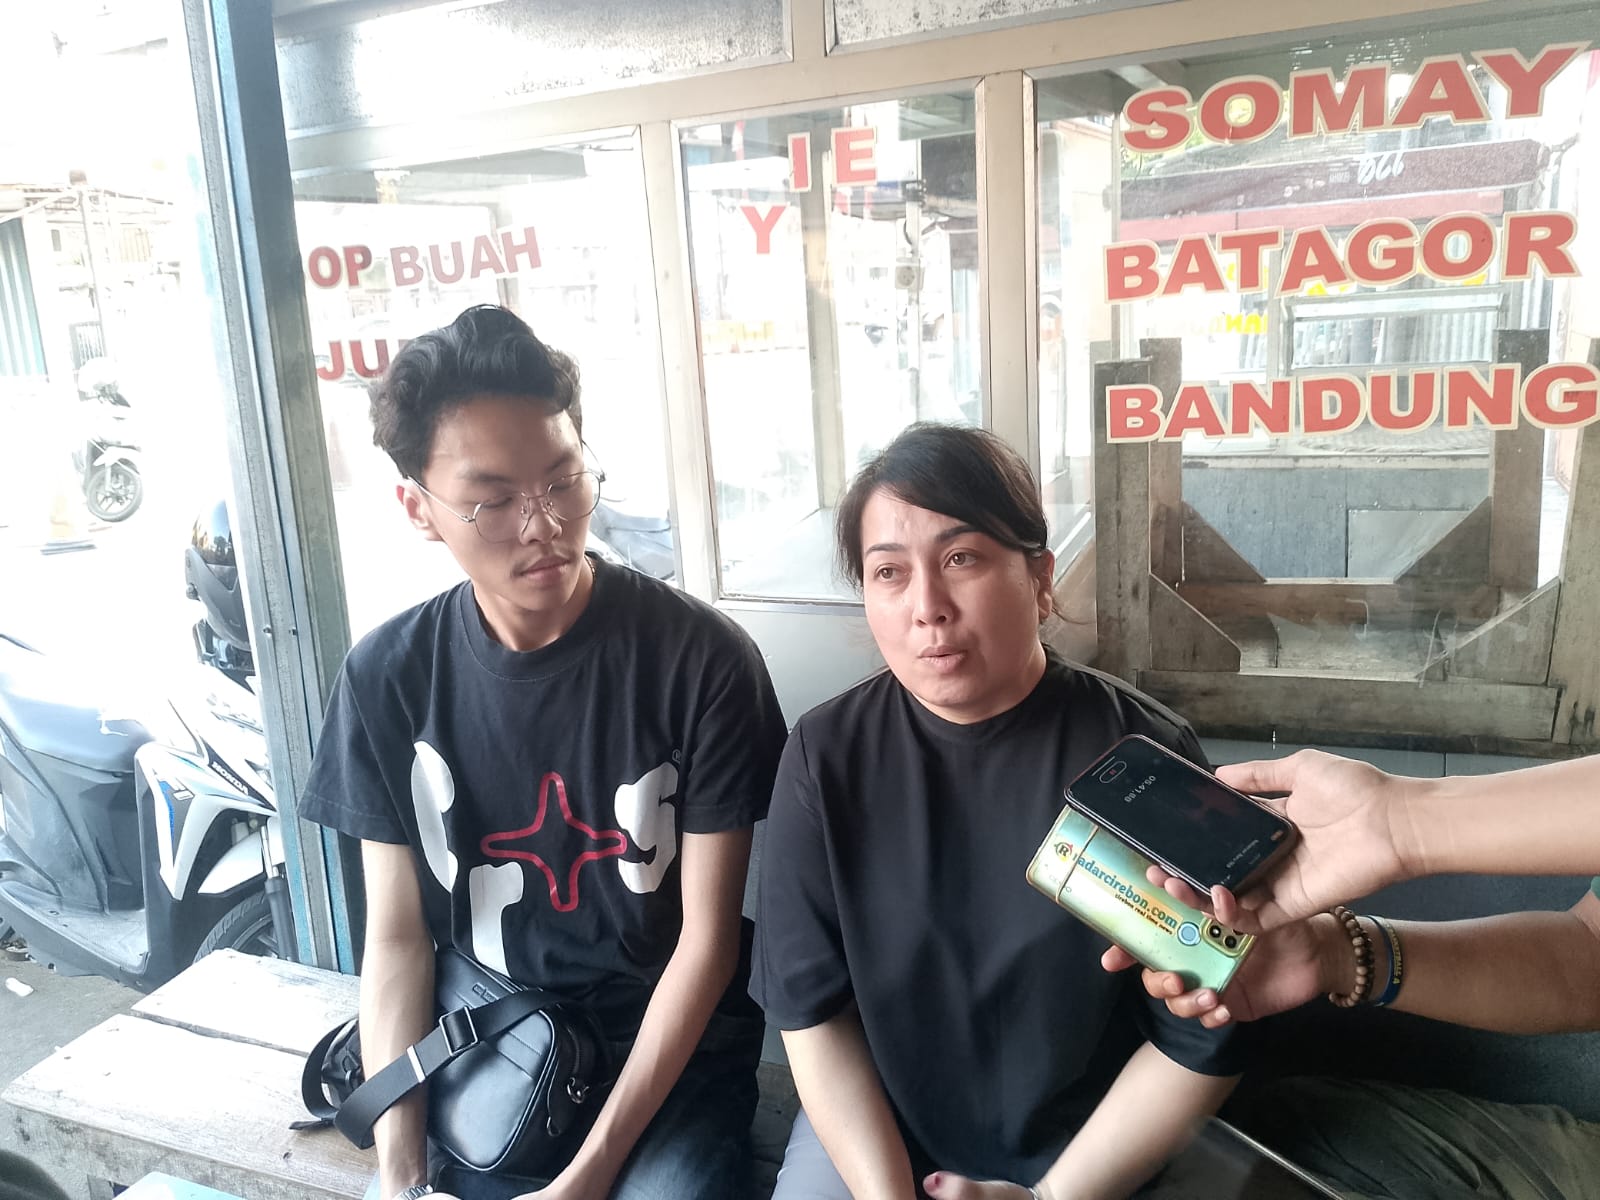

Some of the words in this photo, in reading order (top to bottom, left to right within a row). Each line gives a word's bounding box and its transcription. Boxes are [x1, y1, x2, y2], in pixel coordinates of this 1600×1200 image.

[1122, 41, 1592, 153] SOMAY
[390, 226, 542, 288] BUAH
[739, 205, 787, 255] Y
[1104, 211, 1582, 304] BATAGOR
[316, 337, 410, 381] JU
[1106, 363, 1600, 444] BANDUNG
[211, 760, 249, 796] HONDA
